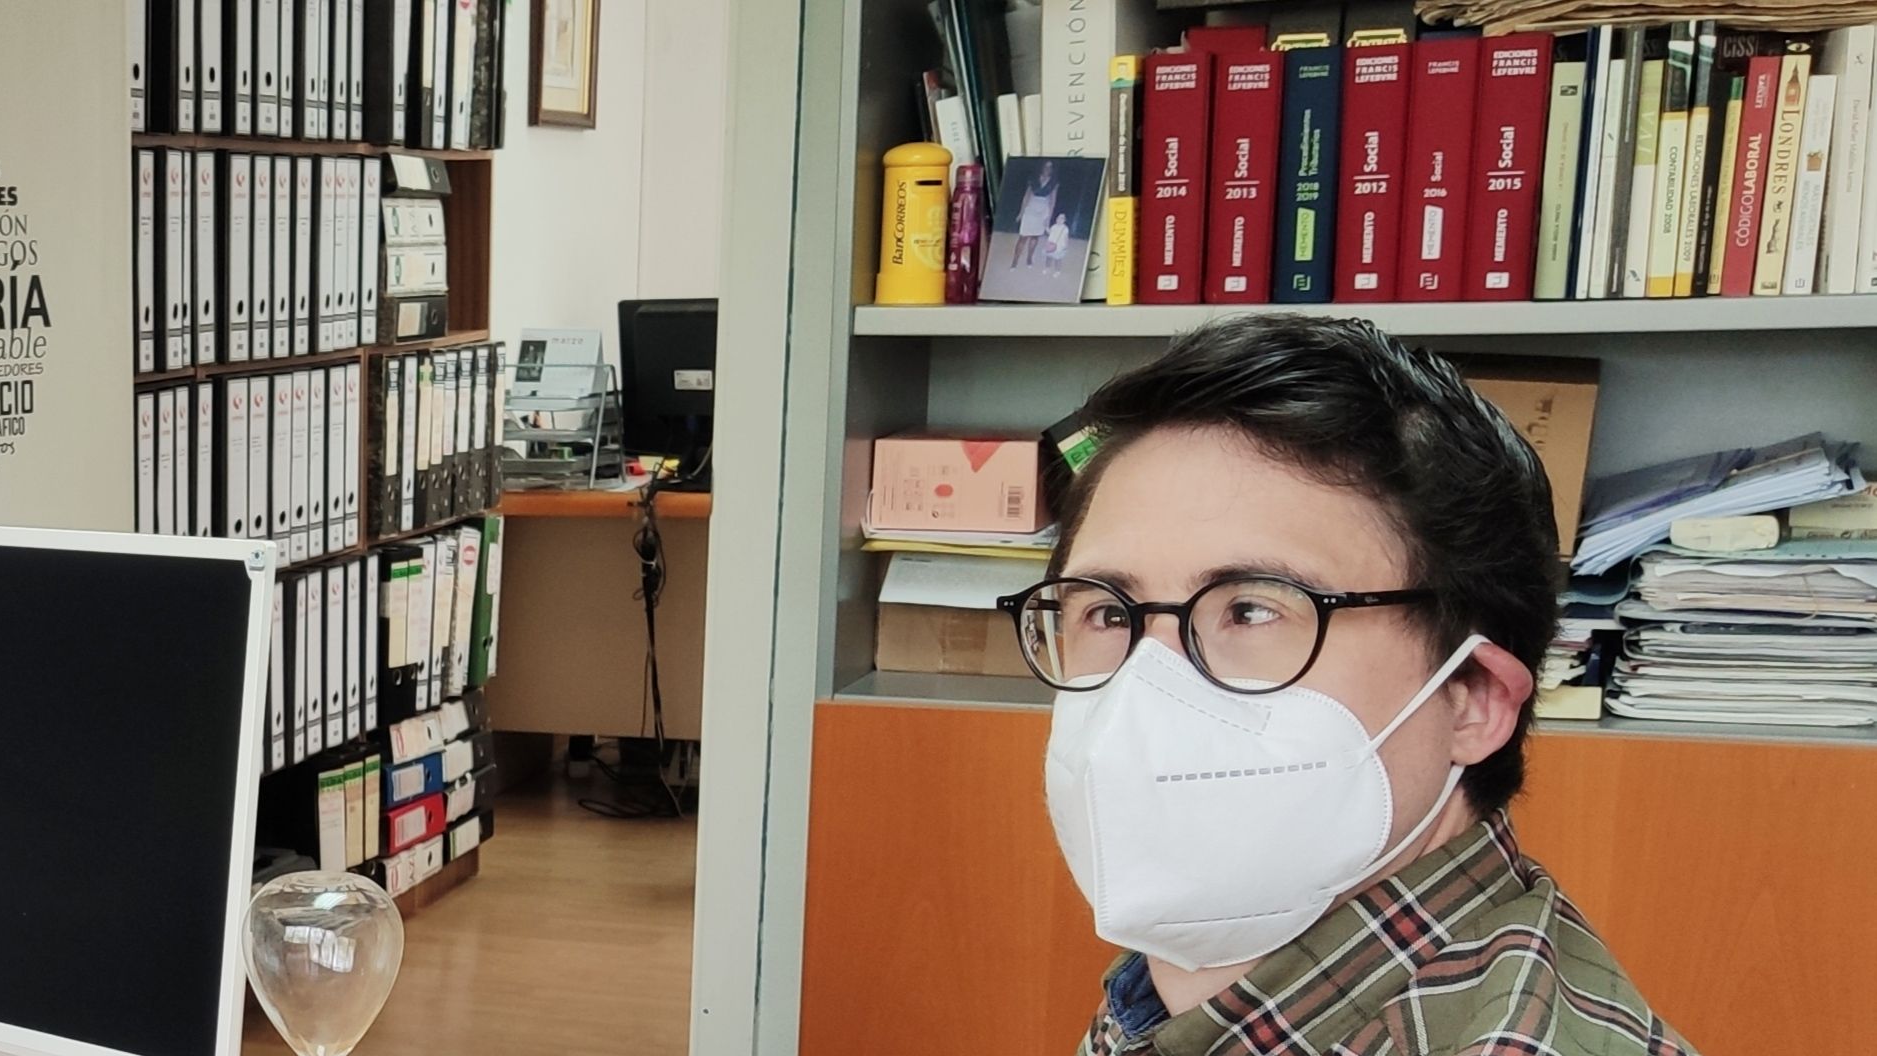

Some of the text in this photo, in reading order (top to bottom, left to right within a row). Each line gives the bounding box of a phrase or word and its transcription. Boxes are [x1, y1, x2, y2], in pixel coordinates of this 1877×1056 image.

[1155, 73, 1196, 82] FRANCIS
[1228, 73, 1270, 82] FRANCIS
[1356, 64, 1398, 74] FRANCIS
[1492, 66, 1536, 76] LEFEBVRE
[1493, 58, 1537, 67] FRANCIS
[1068, 0, 1086, 157] REVENCIÓN
[1155, 81, 1196, 90] LEFEBVRE
[1227, 81, 1269, 90] LEFEBVRE
[1355, 73, 1397, 83] LEFEBVRE
[1165, 138, 1179, 177] Social
[1235, 138, 1250, 178] Social
[1364, 131, 1379, 172] Social
[1499, 126, 1515, 168] Social
[1772, 109, 1800, 194] LONDRES
[1431, 152, 1443, 182] Social
[1155, 186, 1186, 198] 2014
[1225, 187, 1257, 199] 2013
[1296, 182, 1319, 192] 2018
[1296, 191, 1319, 201] 2019
[1354, 181, 1387, 194] 2012
[1423, 187, 1447, 198] 2016
[1488, 177, 1521, 191] 2015
[1663, 146, 1678, 234] CONTABILIDAD 2008
[1682, 134, 1704, 262] RELACIONES LABORALES 2009
[1112, 211, 1127, 277] DUMMIES
[1164, 215, 1175, 265] MEMENTO
[1232, 216, 1244, 267] MEMENTO
[1299, 212, 1309, 257] MEMENTO
[1362, 211, 1375, 264] MEMENTO
[1428, 209, 1438, 256] MEMENTO
[1493, 208, 1508, 262] MEMENTO
